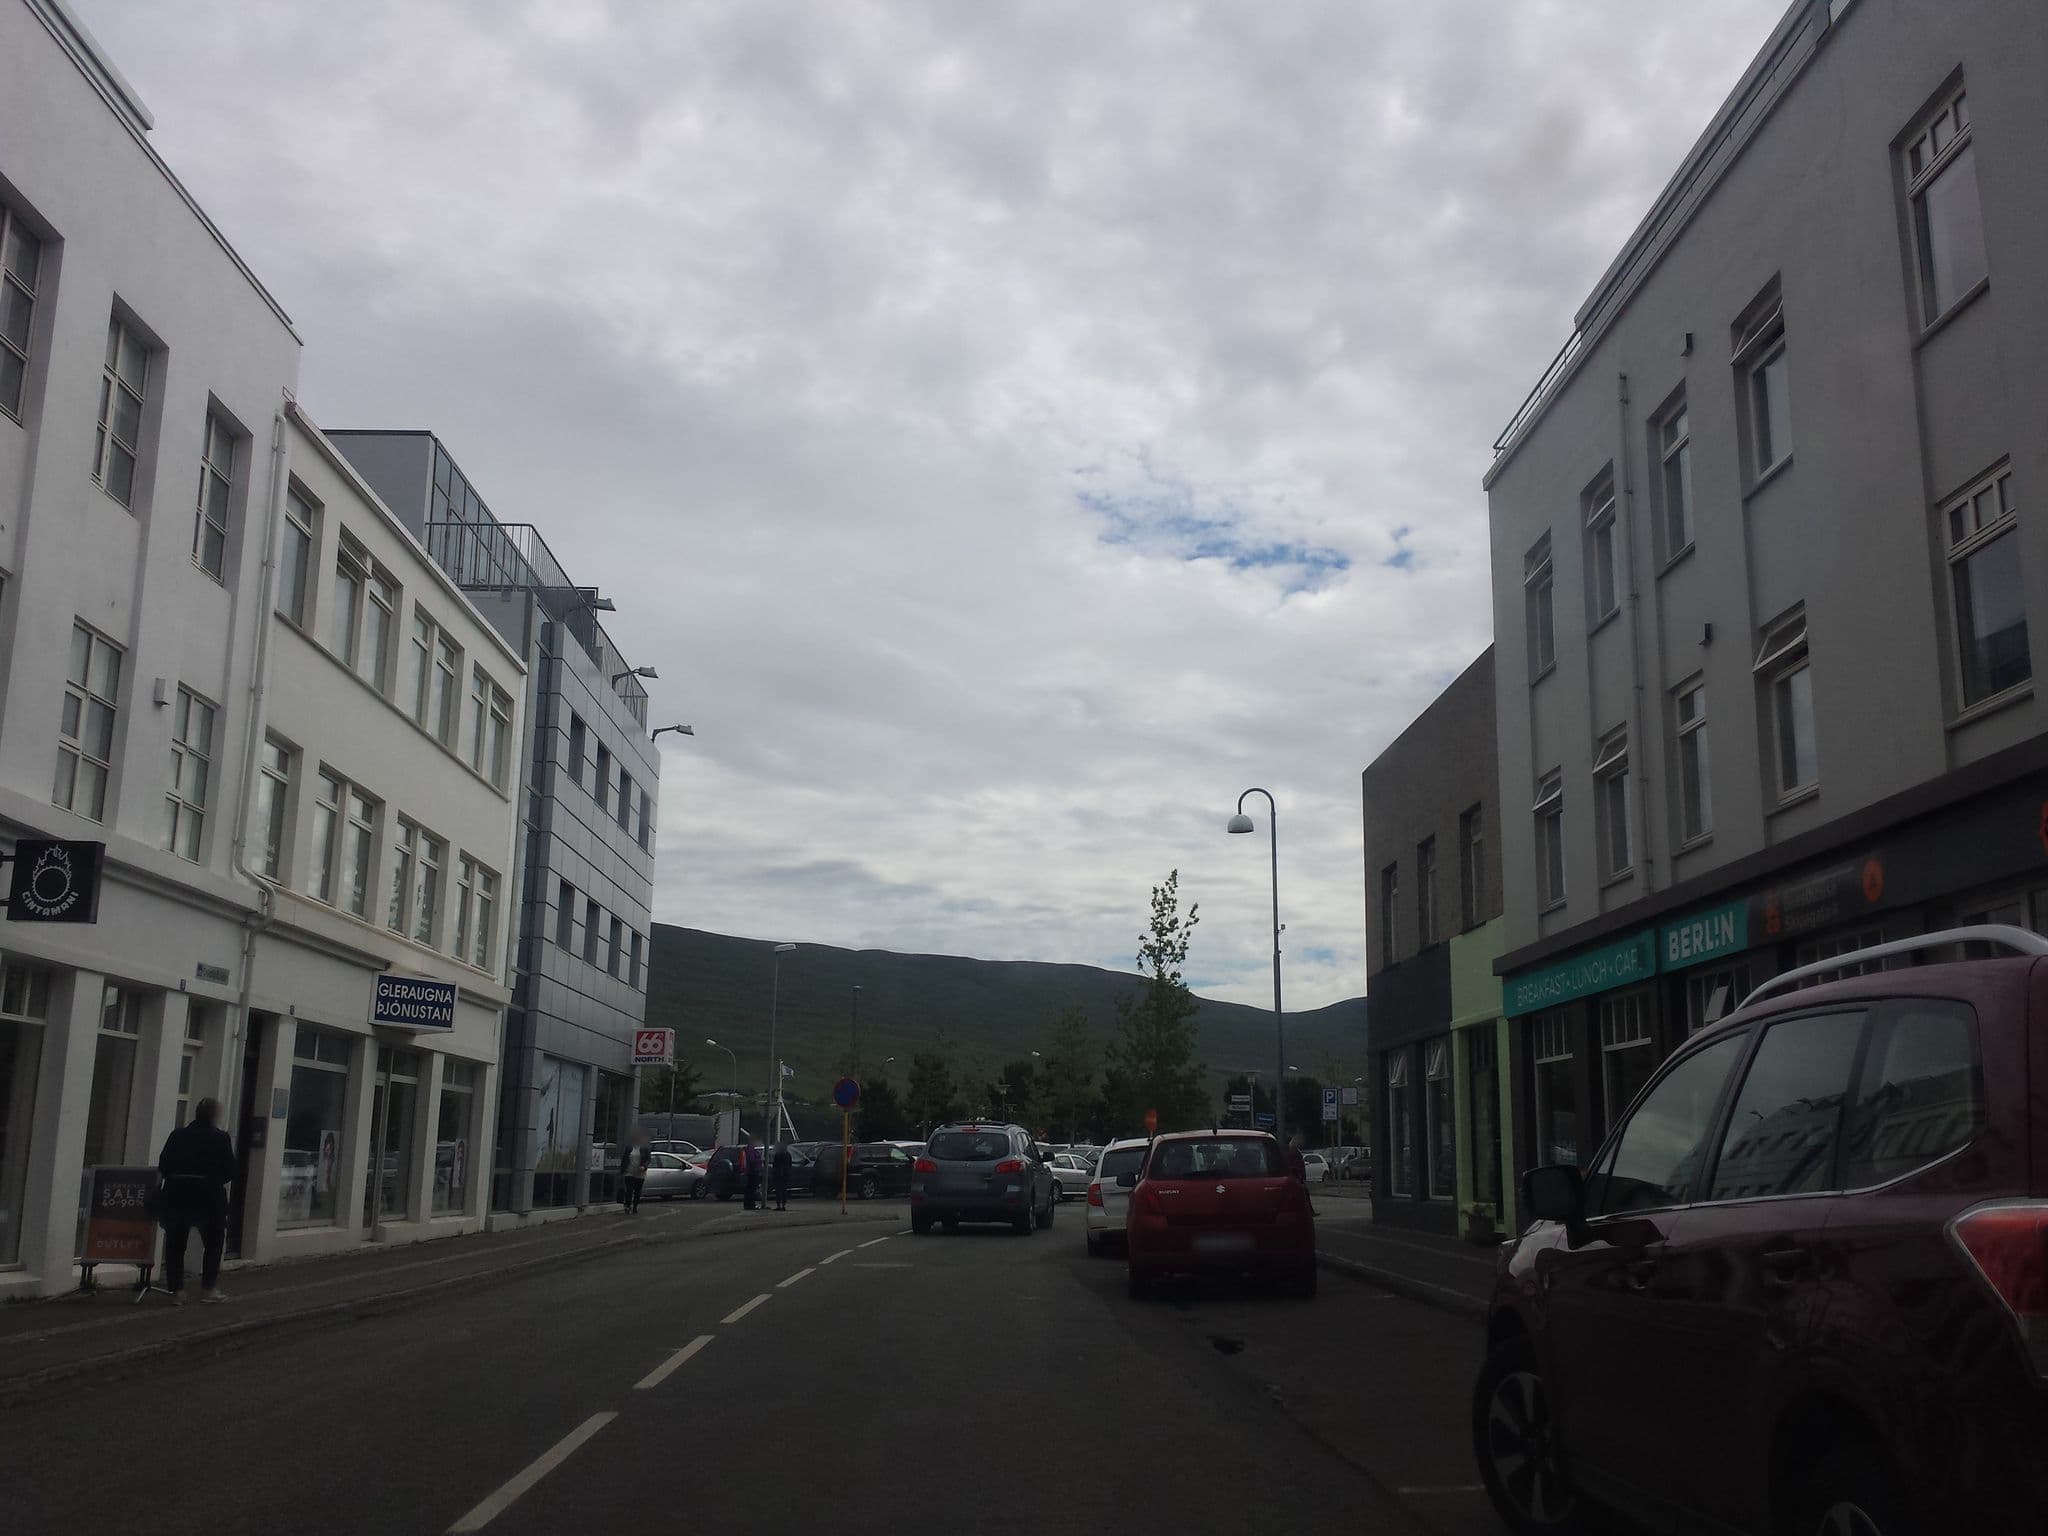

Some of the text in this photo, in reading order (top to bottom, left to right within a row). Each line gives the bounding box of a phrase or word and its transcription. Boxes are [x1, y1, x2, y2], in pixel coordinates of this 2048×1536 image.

[22, 891, 79, 916] CINTAMANI
[1571, 960, 1607, 990] LUNCH
[378, 983, 452, 1004] GLERAUGNA
[376, 1000, 451, 1021] ÞJÓNUSTAN
[103, 1189, 145, 1199] SALE
